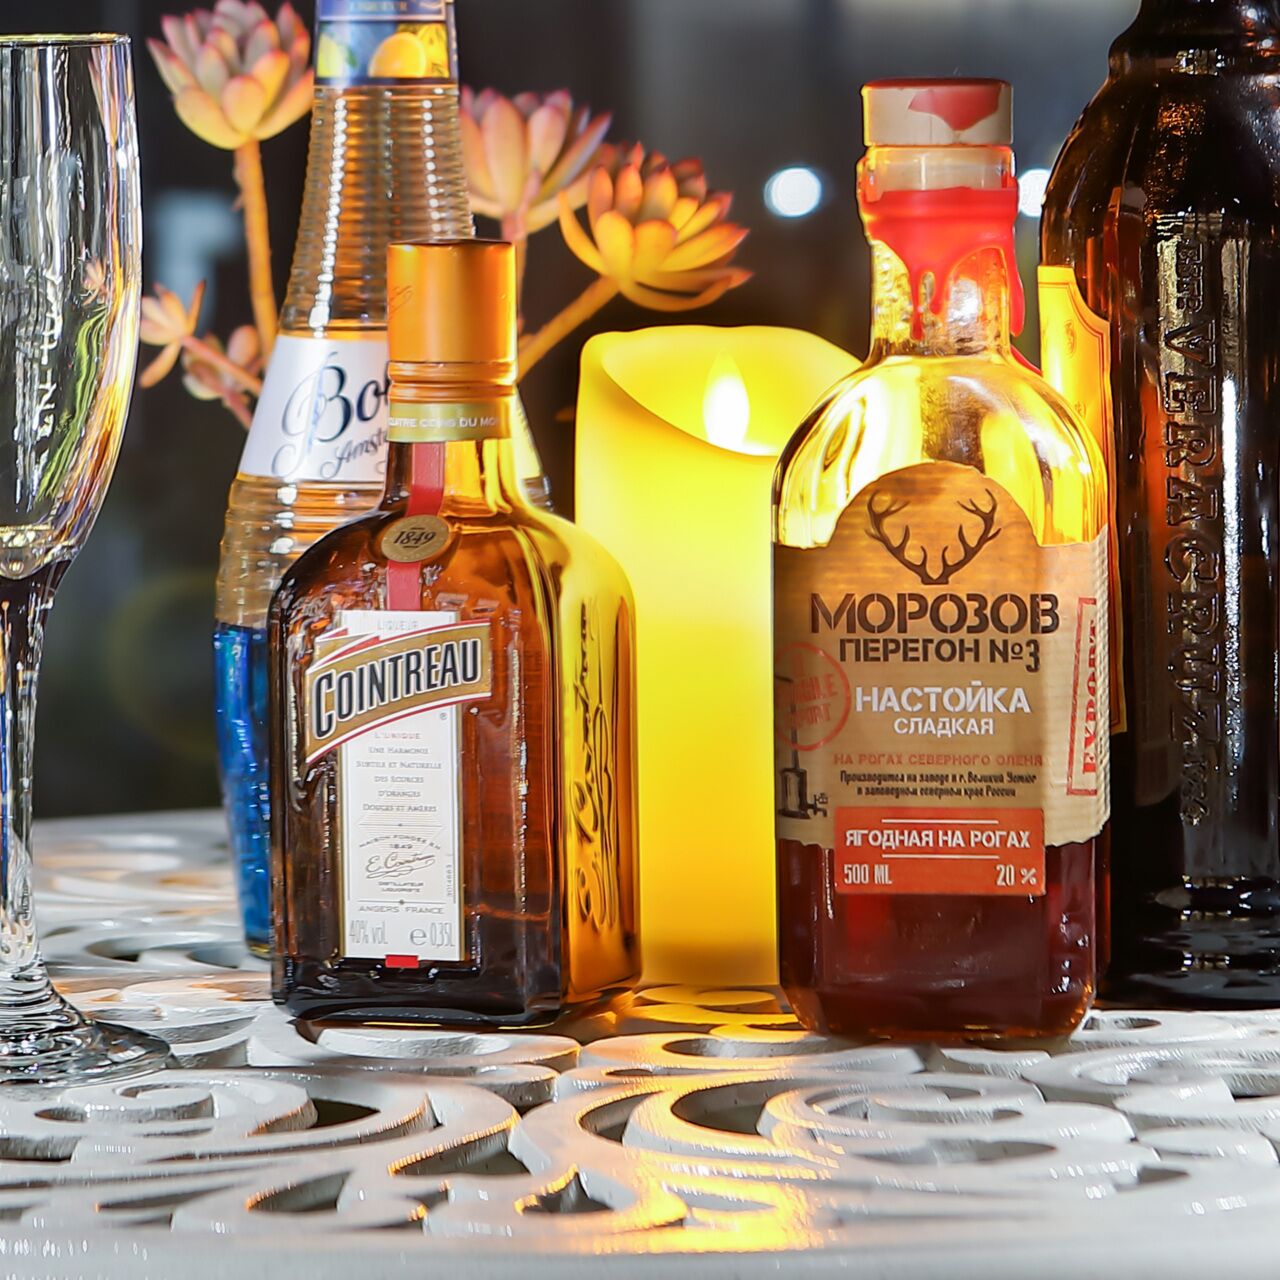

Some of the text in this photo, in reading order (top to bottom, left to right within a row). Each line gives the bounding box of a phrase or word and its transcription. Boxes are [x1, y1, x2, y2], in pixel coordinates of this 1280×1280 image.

[459, 416, 477, 427] DU
[393, 528, 436, 546] 1849
[810, 592, 1060, 635] МОРОЗОВ
[838, 637, 1041, 673] ПЕРЕГОН №3
[313, 639, 481, 739] COINTREAU
[854, 680, 1032, 714] НАСТОЙКА
[893, 716, 995, 739] СЛАДКАЯ
[833, 753, 854, 766] НА
[858, 753, 904, 766] РОГАХ
[908, 753, 991, 767] СЕВЕРНОГО
[845, 829, 1031, 850] ЯГОДНАЯ НА РОГАХ
[843, 863, 893, 885] 500 ML
[995, 863, 1038, 887] 20 %
